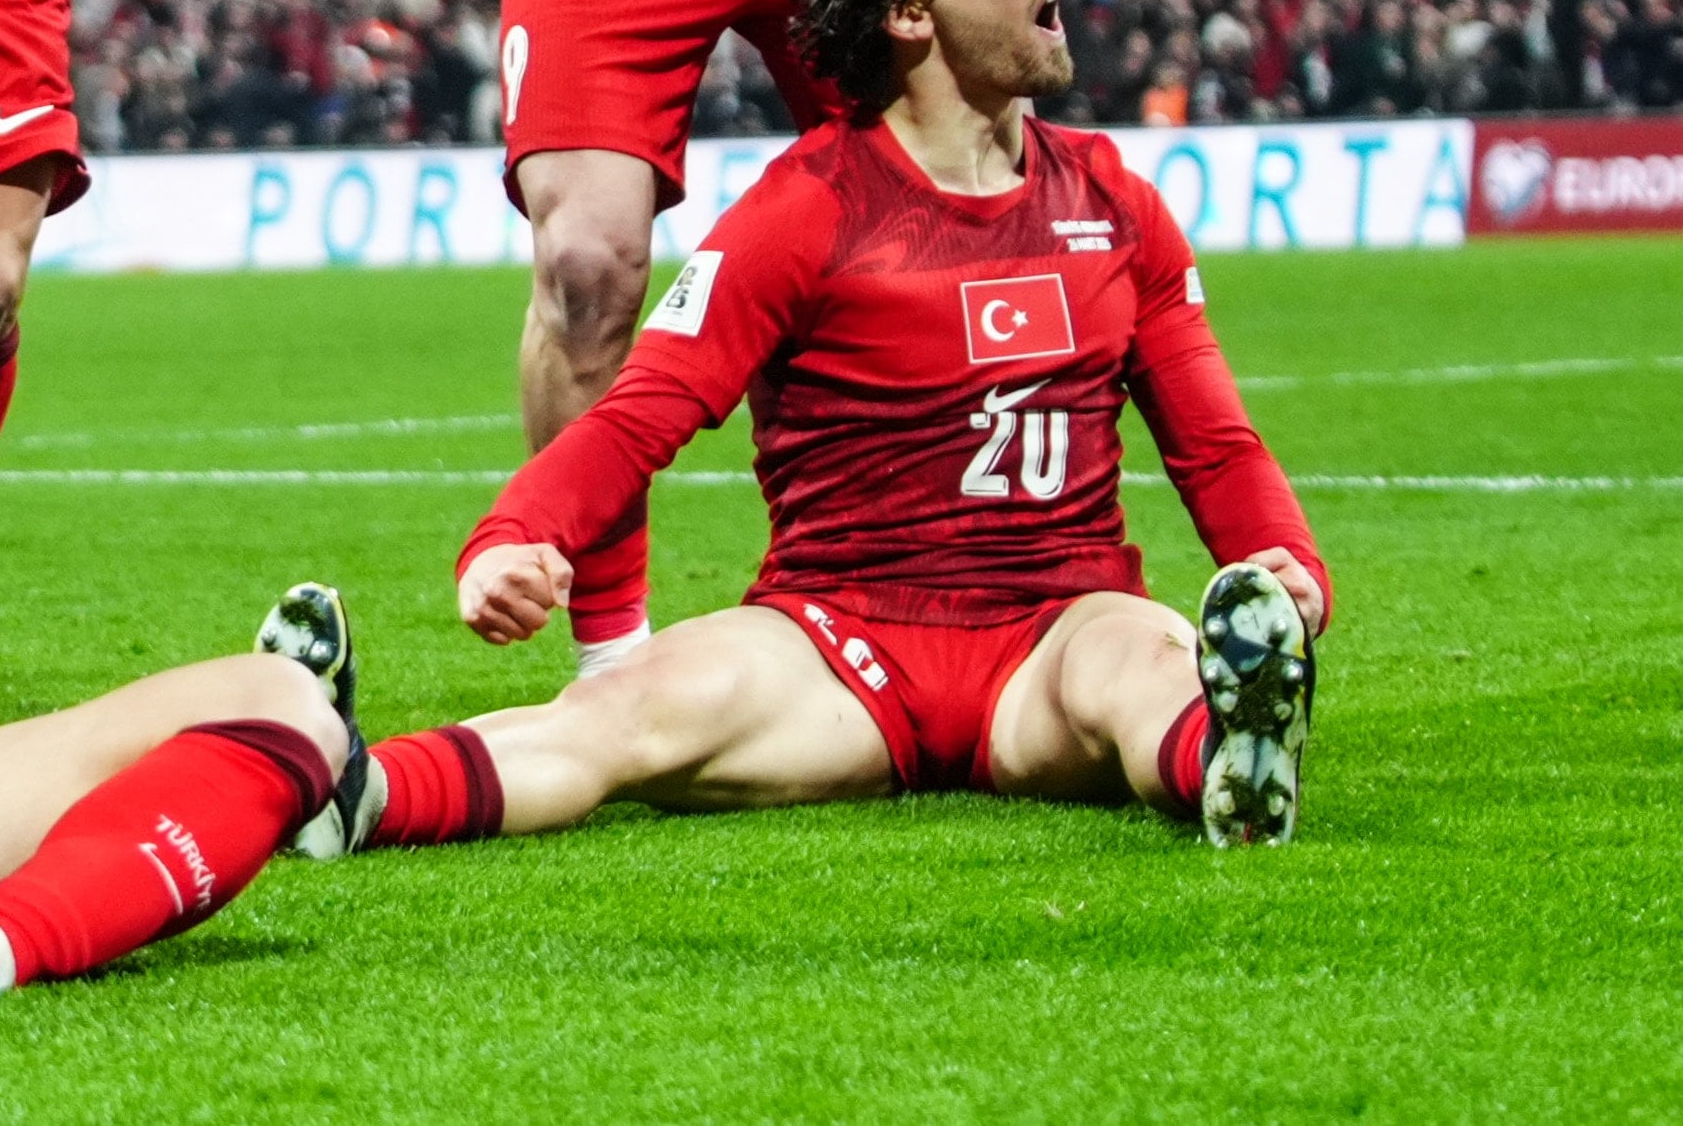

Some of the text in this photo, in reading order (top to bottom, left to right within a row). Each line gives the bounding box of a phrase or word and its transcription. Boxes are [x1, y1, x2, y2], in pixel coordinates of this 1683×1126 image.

[503, 25, 529, 126] 9
[1154, 136, 1469, 252] ORTA
[959, 409, 1069, 501] 20
